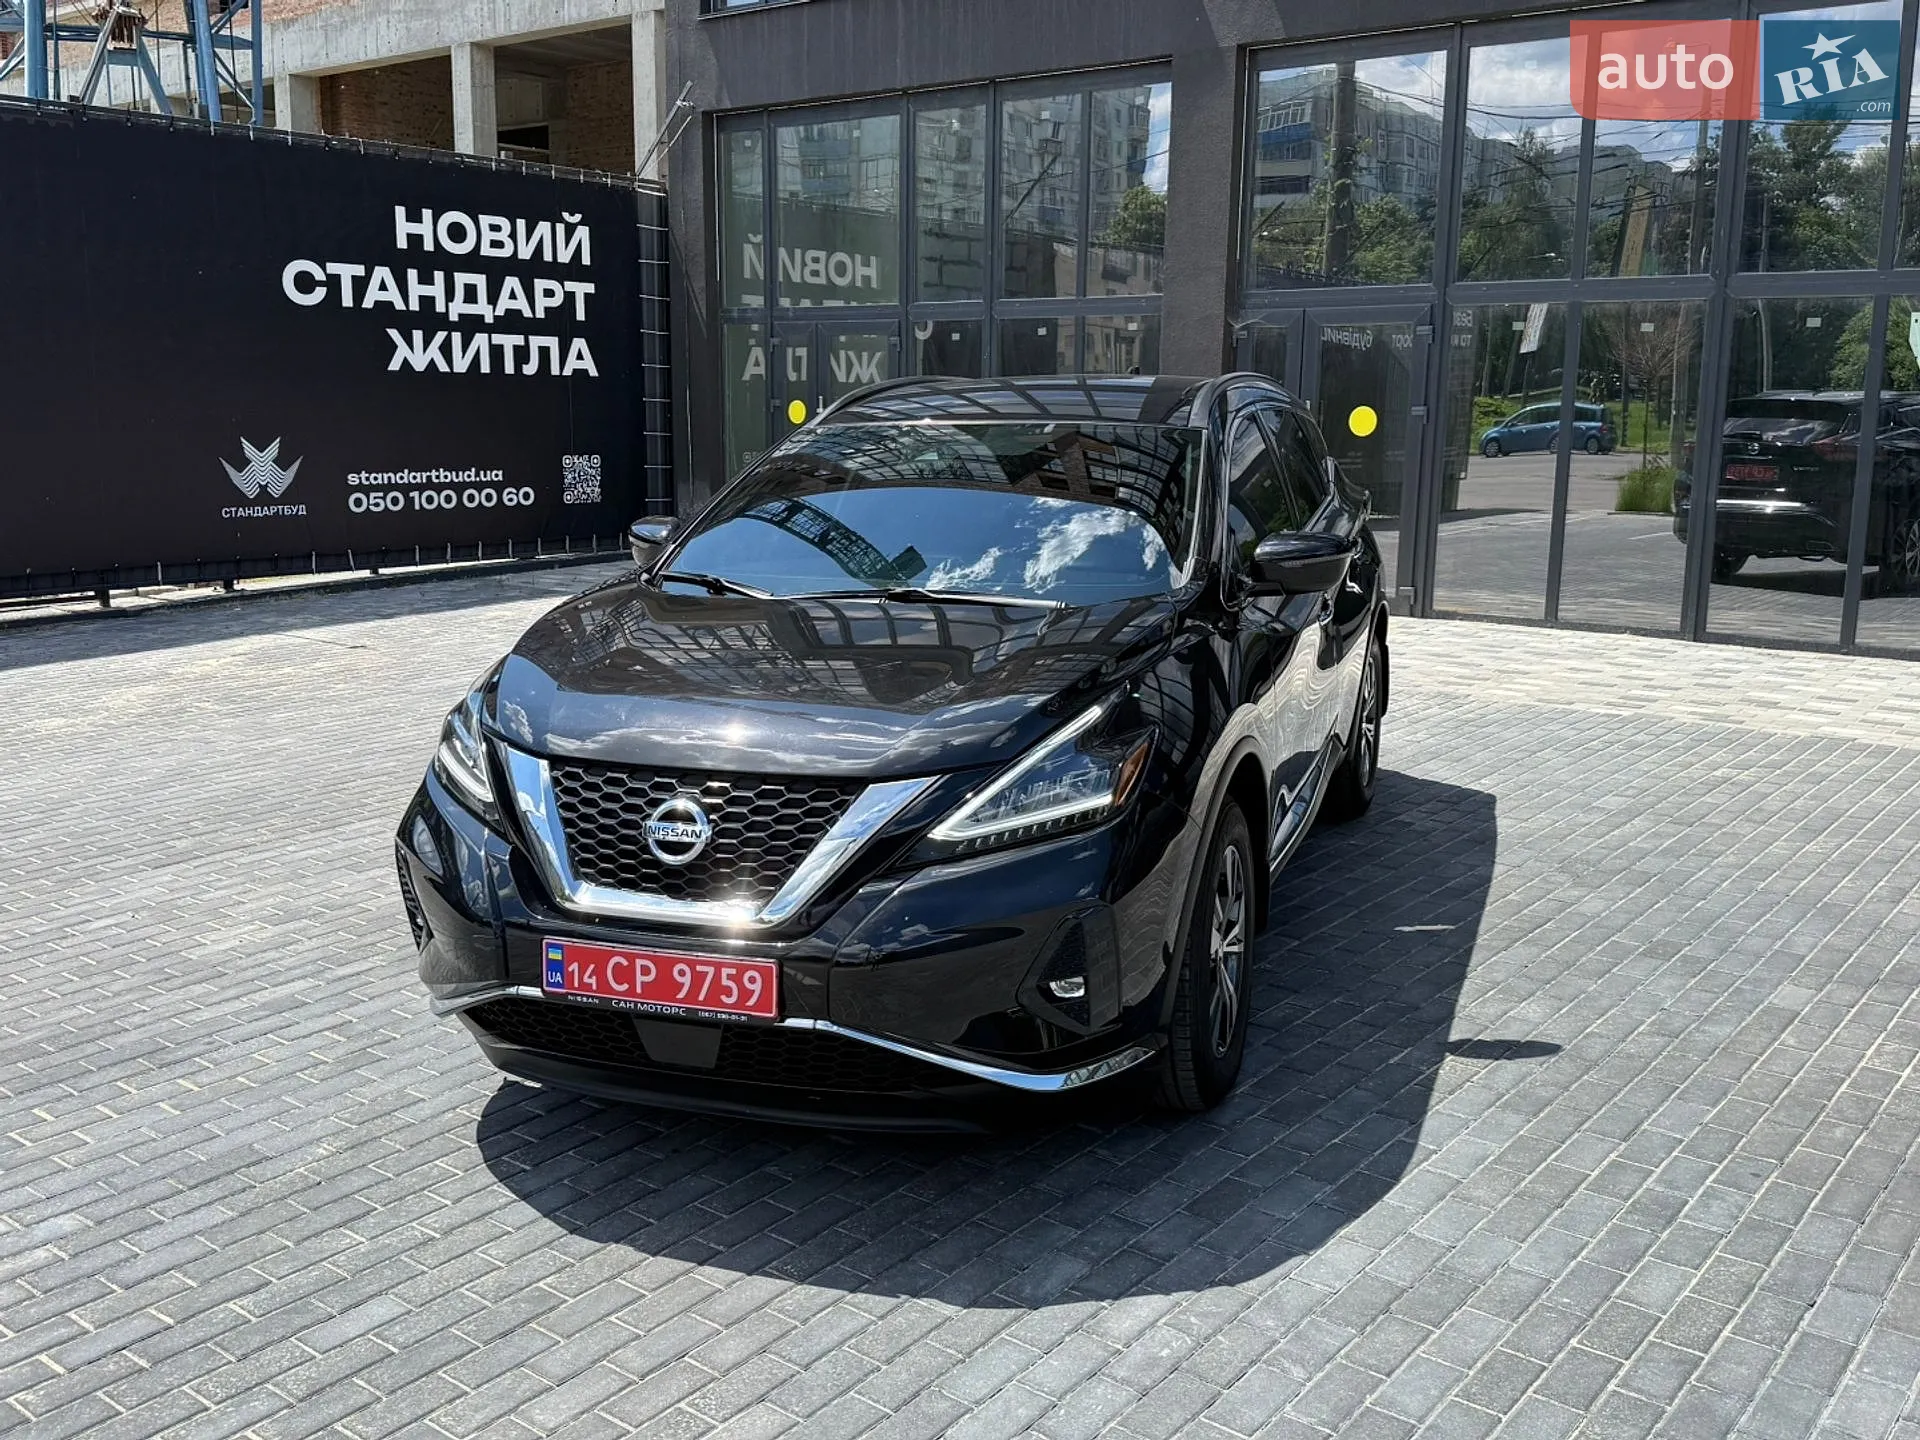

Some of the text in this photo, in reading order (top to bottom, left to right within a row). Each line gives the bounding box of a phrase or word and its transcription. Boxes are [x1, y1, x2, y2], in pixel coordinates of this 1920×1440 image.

[394, 205, 592, 266] НОВИЙ
[281, 259, 596, 324] СТАНДАРТ
[385, 327, 599, 377] ЖИТЛА
[347, 468, 503, 485] standartbud.ua
[347, 486, 535, 513] 050 100 00 60
[221, 504, 307, 518] СТАНДАРТБУД
[648, 824, 703, 839] NISSAN
[548, 971, 562, 983] UA
[568, 961, 597, 990] 14
[672, 963, 762, 1006] 9759
[568, 994, 599, 1004] NISSAN
